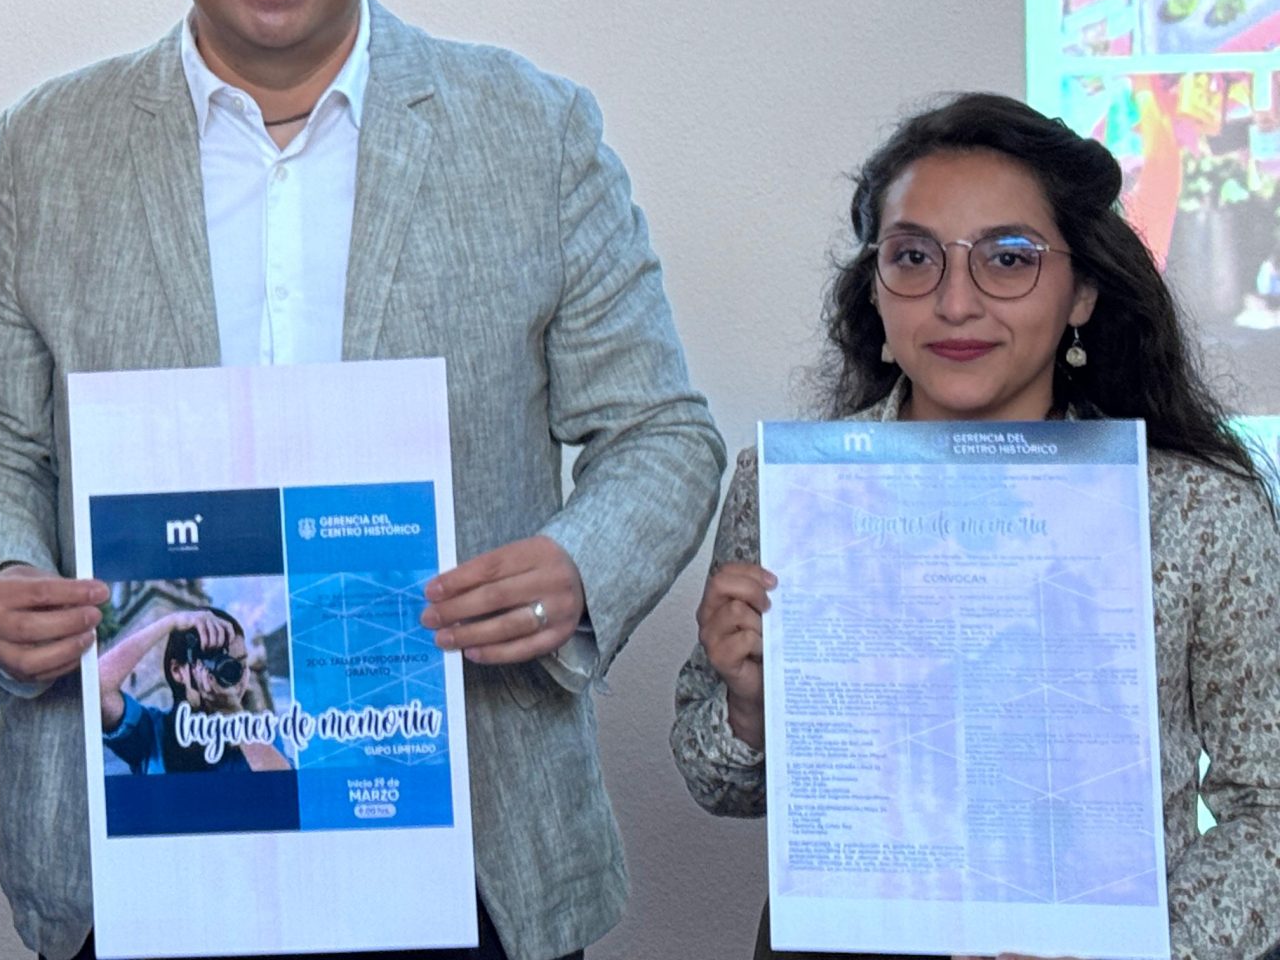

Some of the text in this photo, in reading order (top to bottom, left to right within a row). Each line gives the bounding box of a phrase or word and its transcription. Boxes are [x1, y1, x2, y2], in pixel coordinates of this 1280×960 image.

[952, 432, 1026, 444] GERENCIA DEL
[952, 444, 997, 455] CENTRO
[319, 513, 391, 527] GERENCIA DEL
[320, 522, 421, 538] CENTRO HISTÓRICO
[175, 698, 441, 764] lugares de memoria
[363, 743, 437, 756] CUPO LIMITADO
[347, 778, 373, 788] Inicio
[386, 777, 400, 787] de
[349, 788, 400, 802] MARZO
